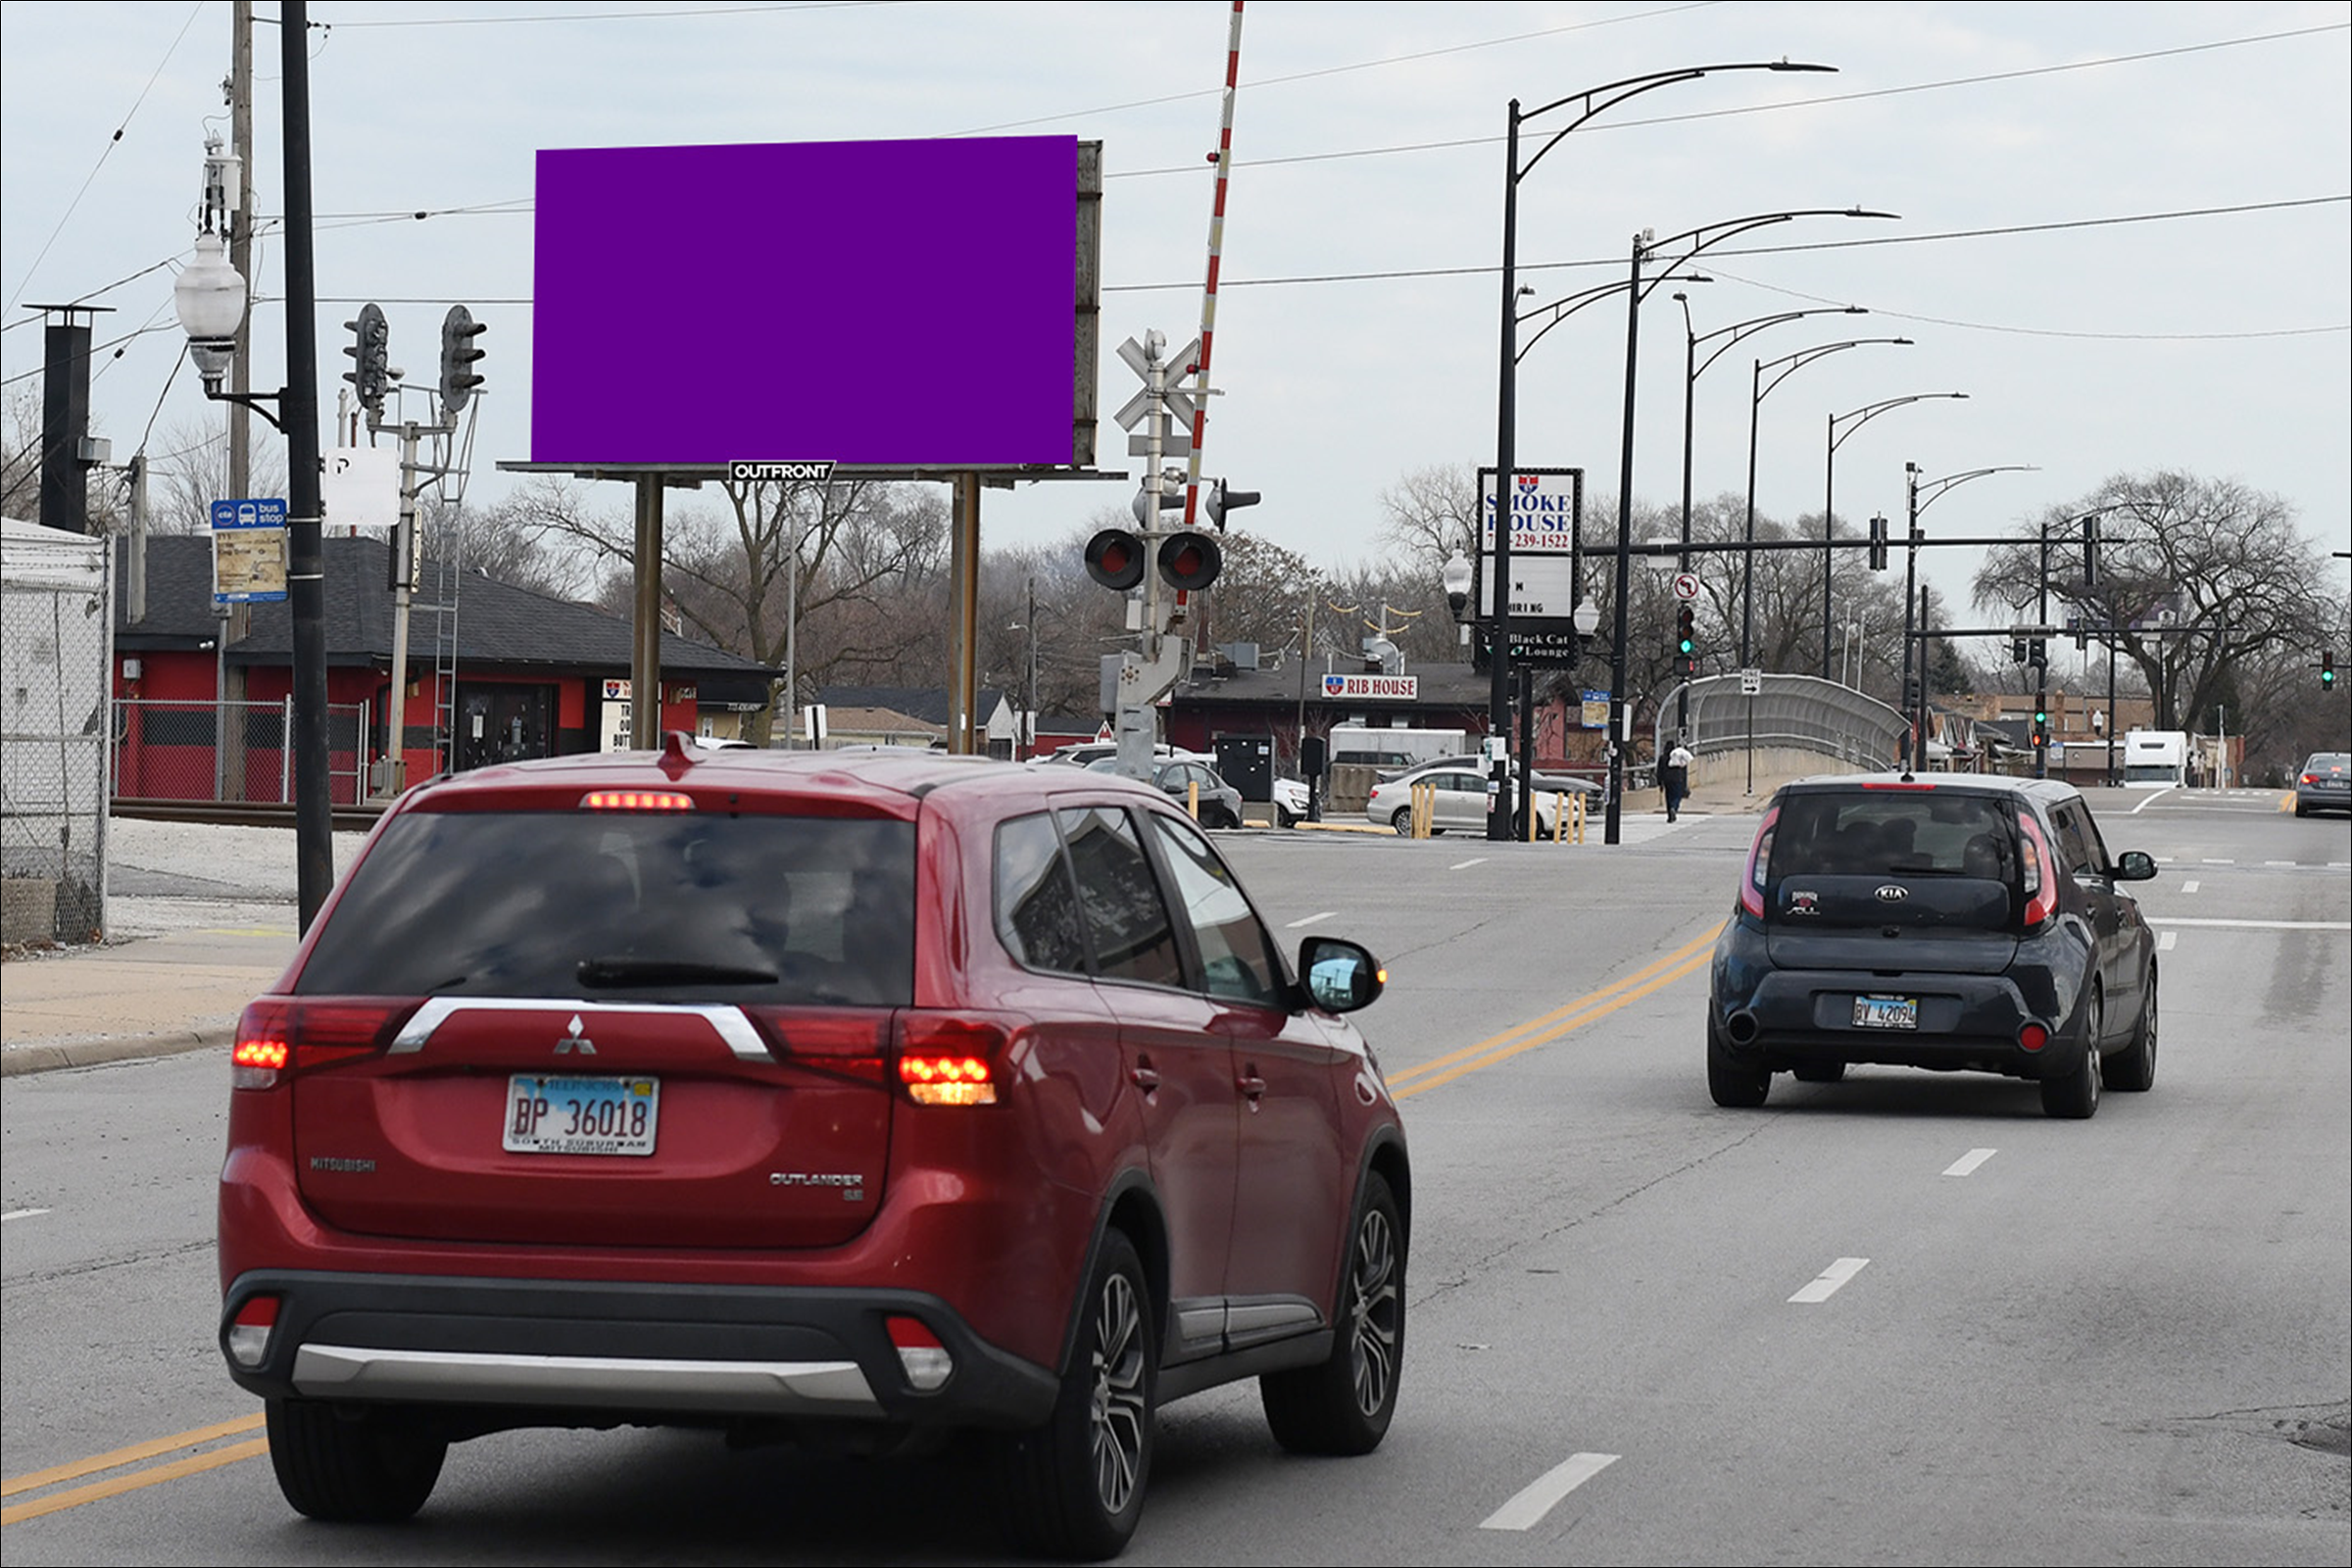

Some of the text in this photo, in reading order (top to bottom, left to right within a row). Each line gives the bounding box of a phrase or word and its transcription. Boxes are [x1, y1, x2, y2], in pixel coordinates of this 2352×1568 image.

[734, 465, 829, 478] OUTFRONT
[259, 503, 279, 513] bus
[259, 514, 283, 524] stop
[1488, 533, 1568, 547] 7-239-1522
[1509, 634, 1568, 644] Black Cat
[1526, 647, 1569, 658] Lounge
[1347, 679, 1414, 695] RIB HOUSE
[1880, 889, 1902, 899] KIA
[1855, 1004, 1916, 1021] BV 42094
[514, 1098, 647, 1137] BP 36018
[311, 1157, 375, 1171] MITSUBISHI
[769, 1172, 863, 1186] OUTLANDER
